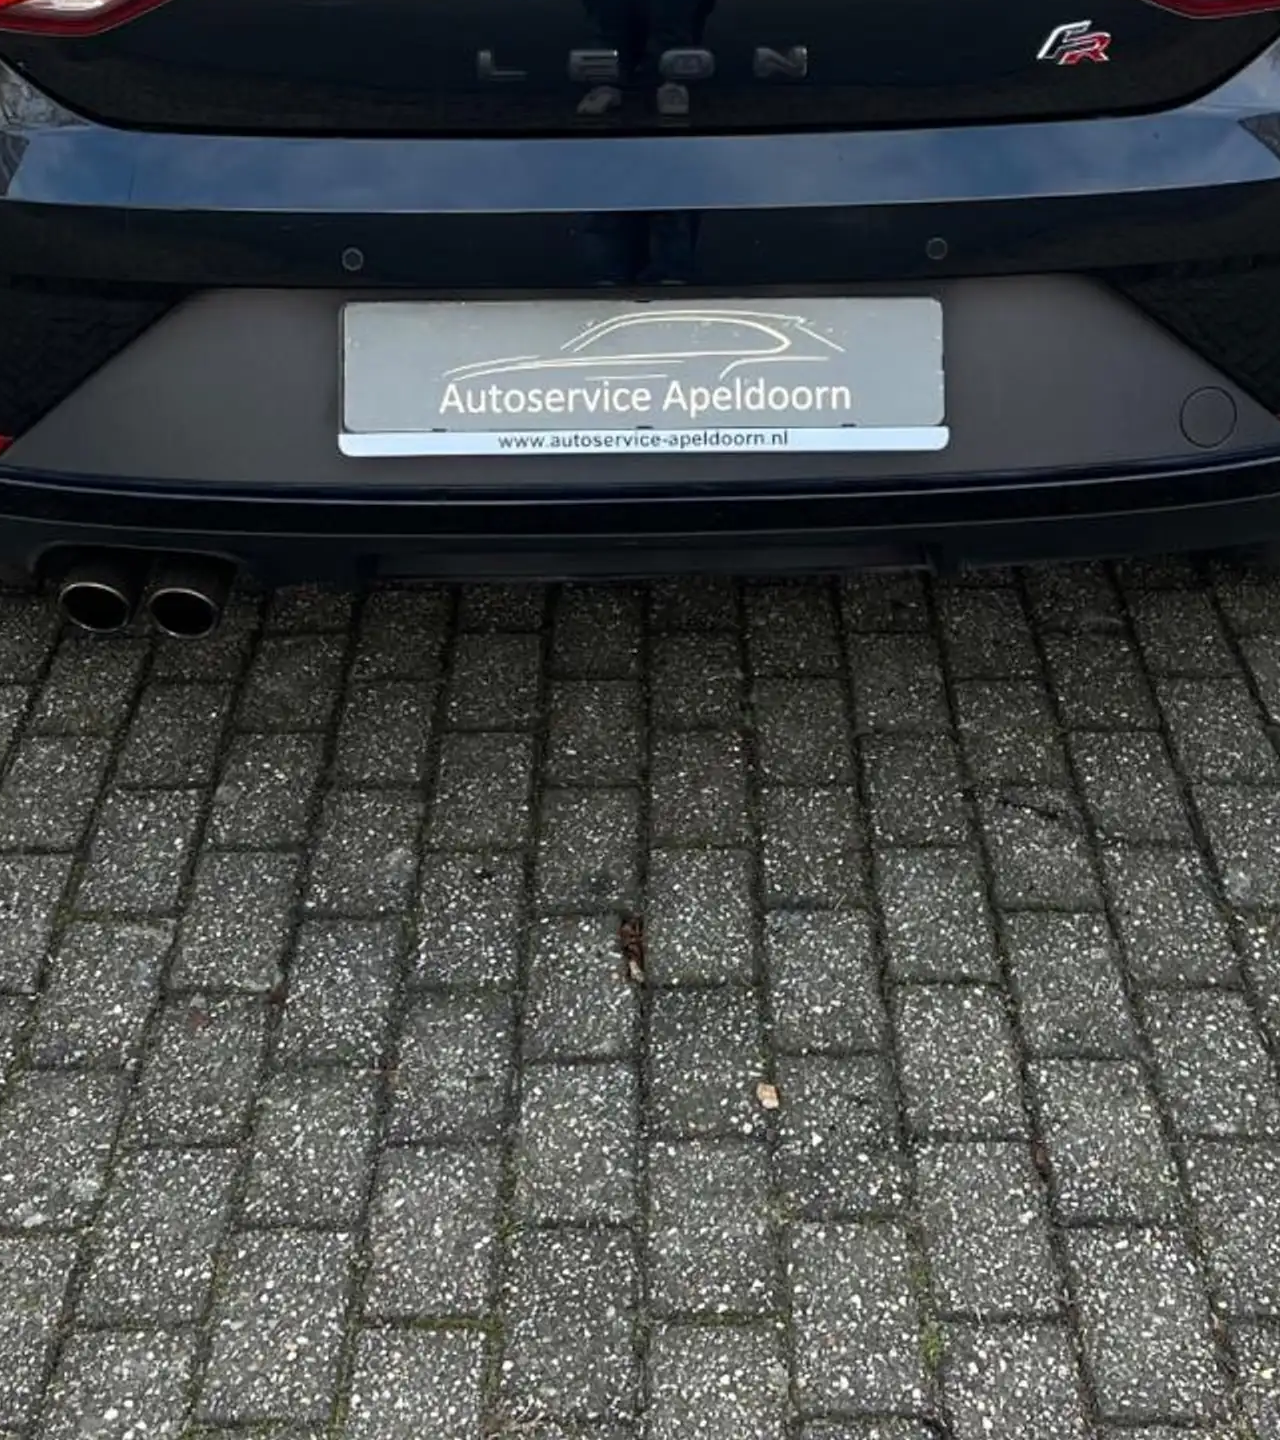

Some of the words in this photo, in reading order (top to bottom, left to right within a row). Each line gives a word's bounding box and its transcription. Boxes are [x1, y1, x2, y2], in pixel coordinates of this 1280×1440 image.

[1036, 20, 1112, 65] FR
[476, 47, 808, 81] LEON
[439, 379, 652, 415] Autoservice
[662, 378, 852, 418] Apeldoorn
[497, 428, 789, 451] www.autoservice-apeldoorn.nl
